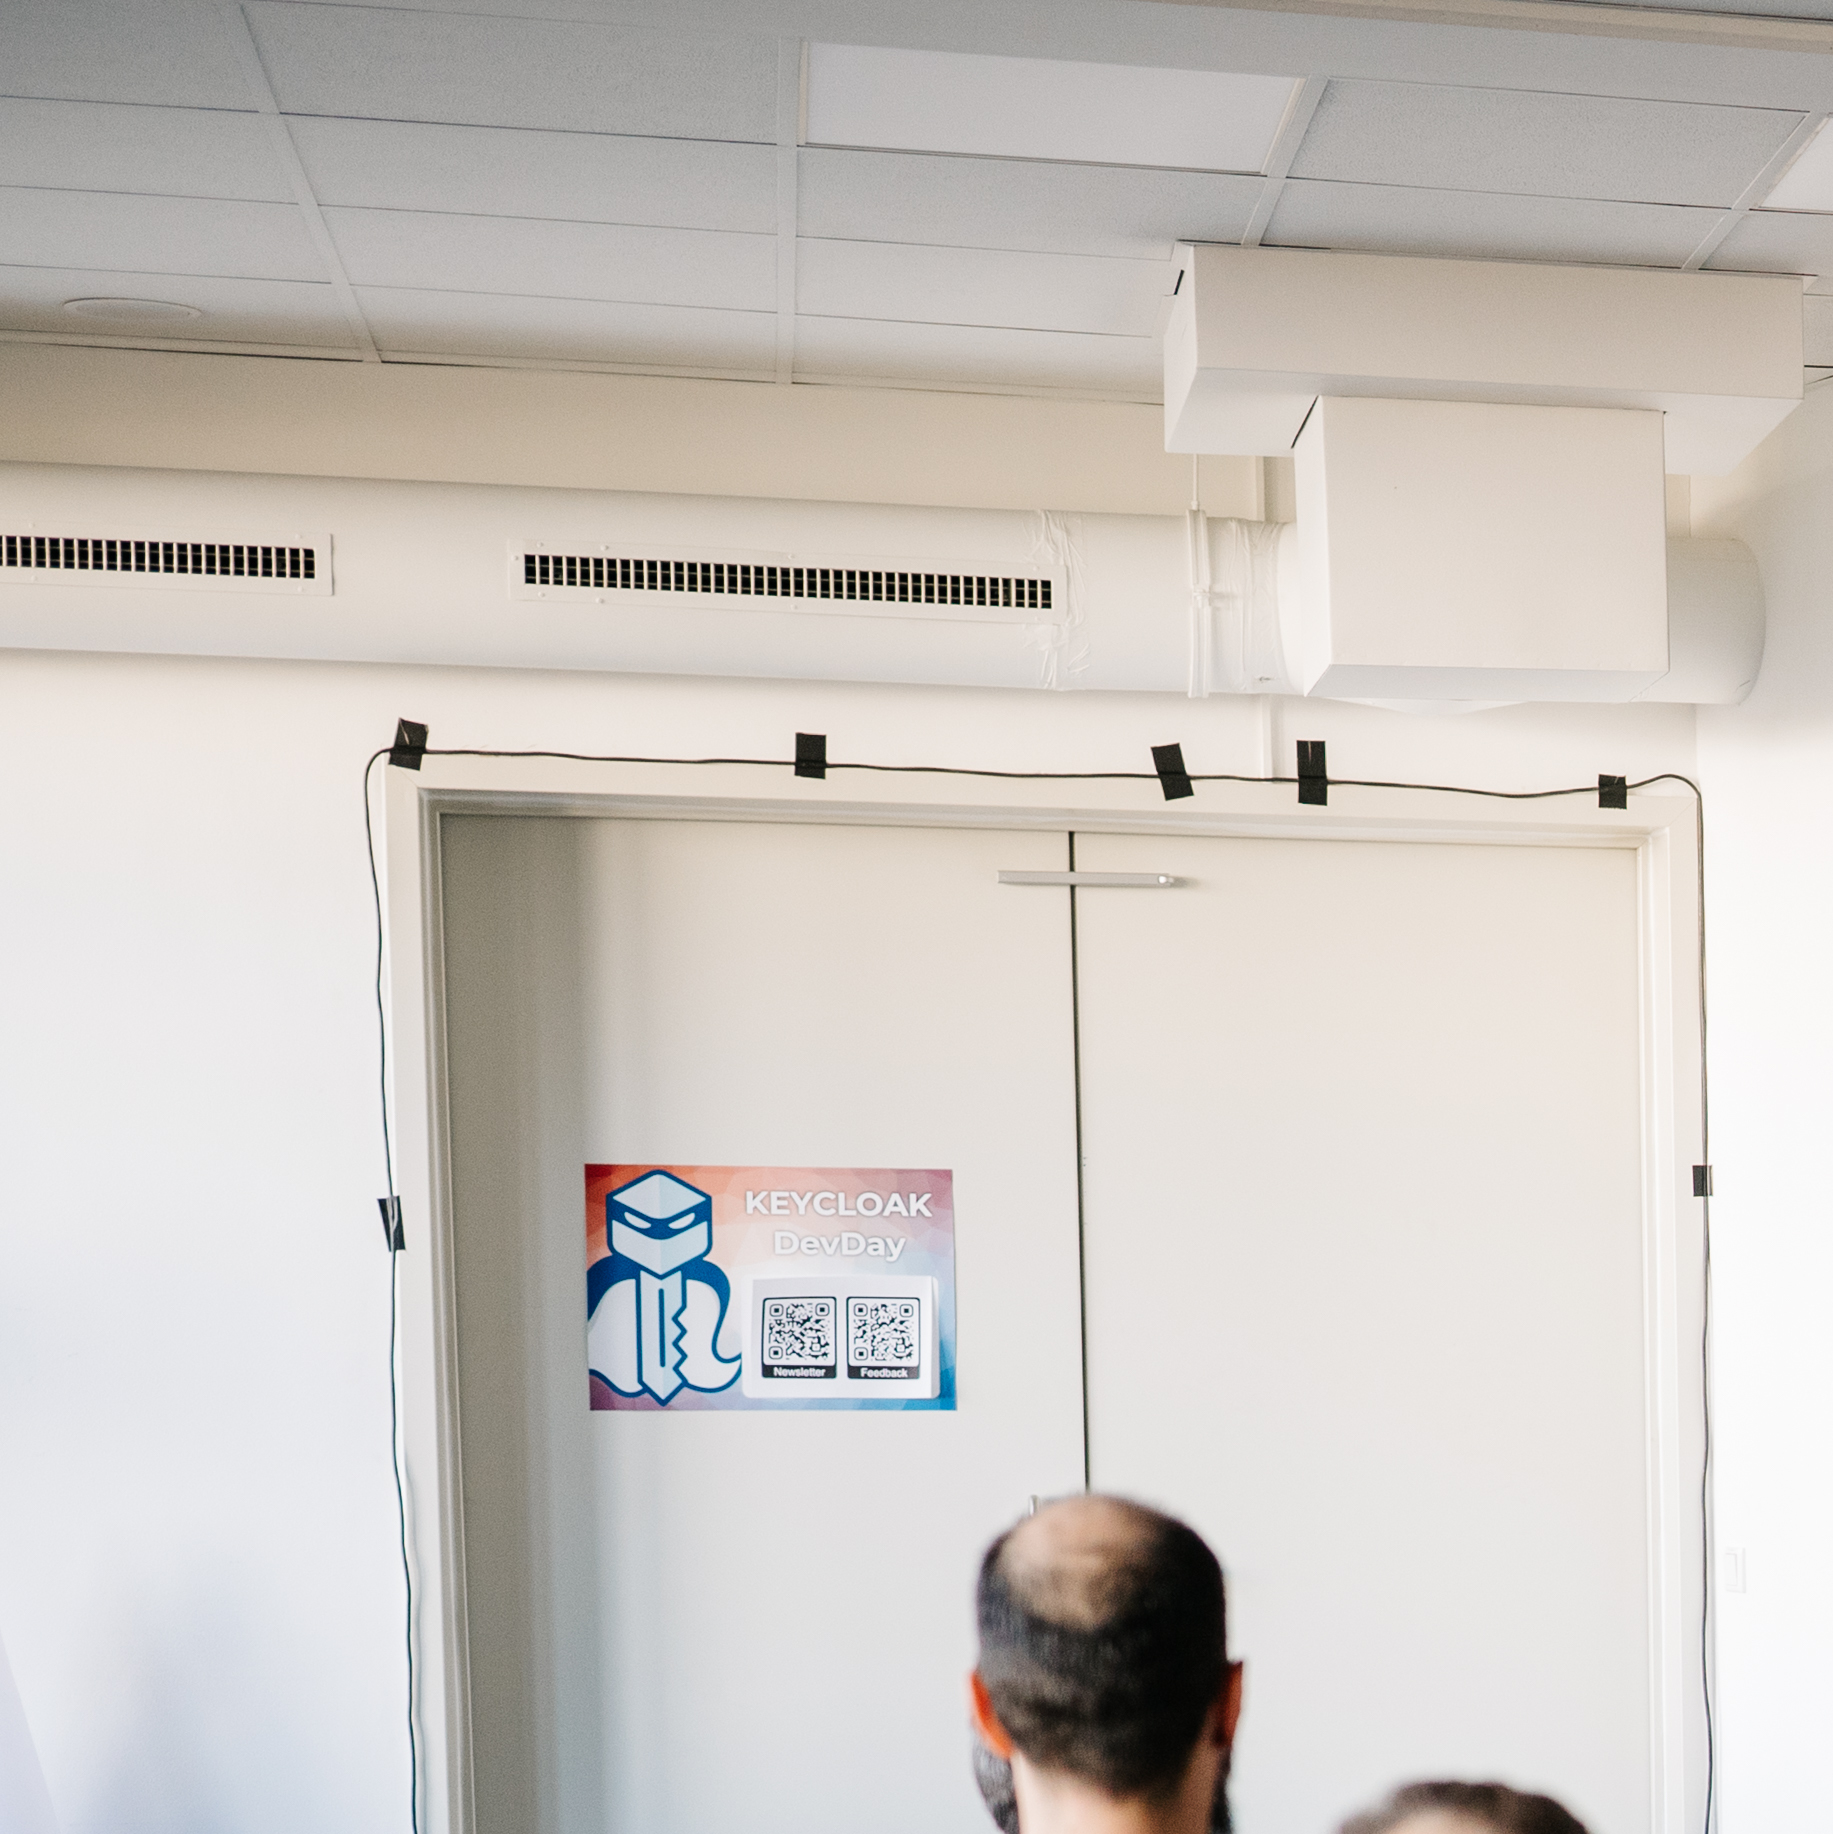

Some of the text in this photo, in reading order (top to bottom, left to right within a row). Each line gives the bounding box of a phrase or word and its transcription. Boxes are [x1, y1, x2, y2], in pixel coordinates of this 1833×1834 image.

[745, 1190, 933, 1219] KEYCLOAK
[773, 1230, 906, 1263] DevDay
[773, 1366, 826, 1378] Newsletter
[860, 1366, 909, 1379] Feedback
